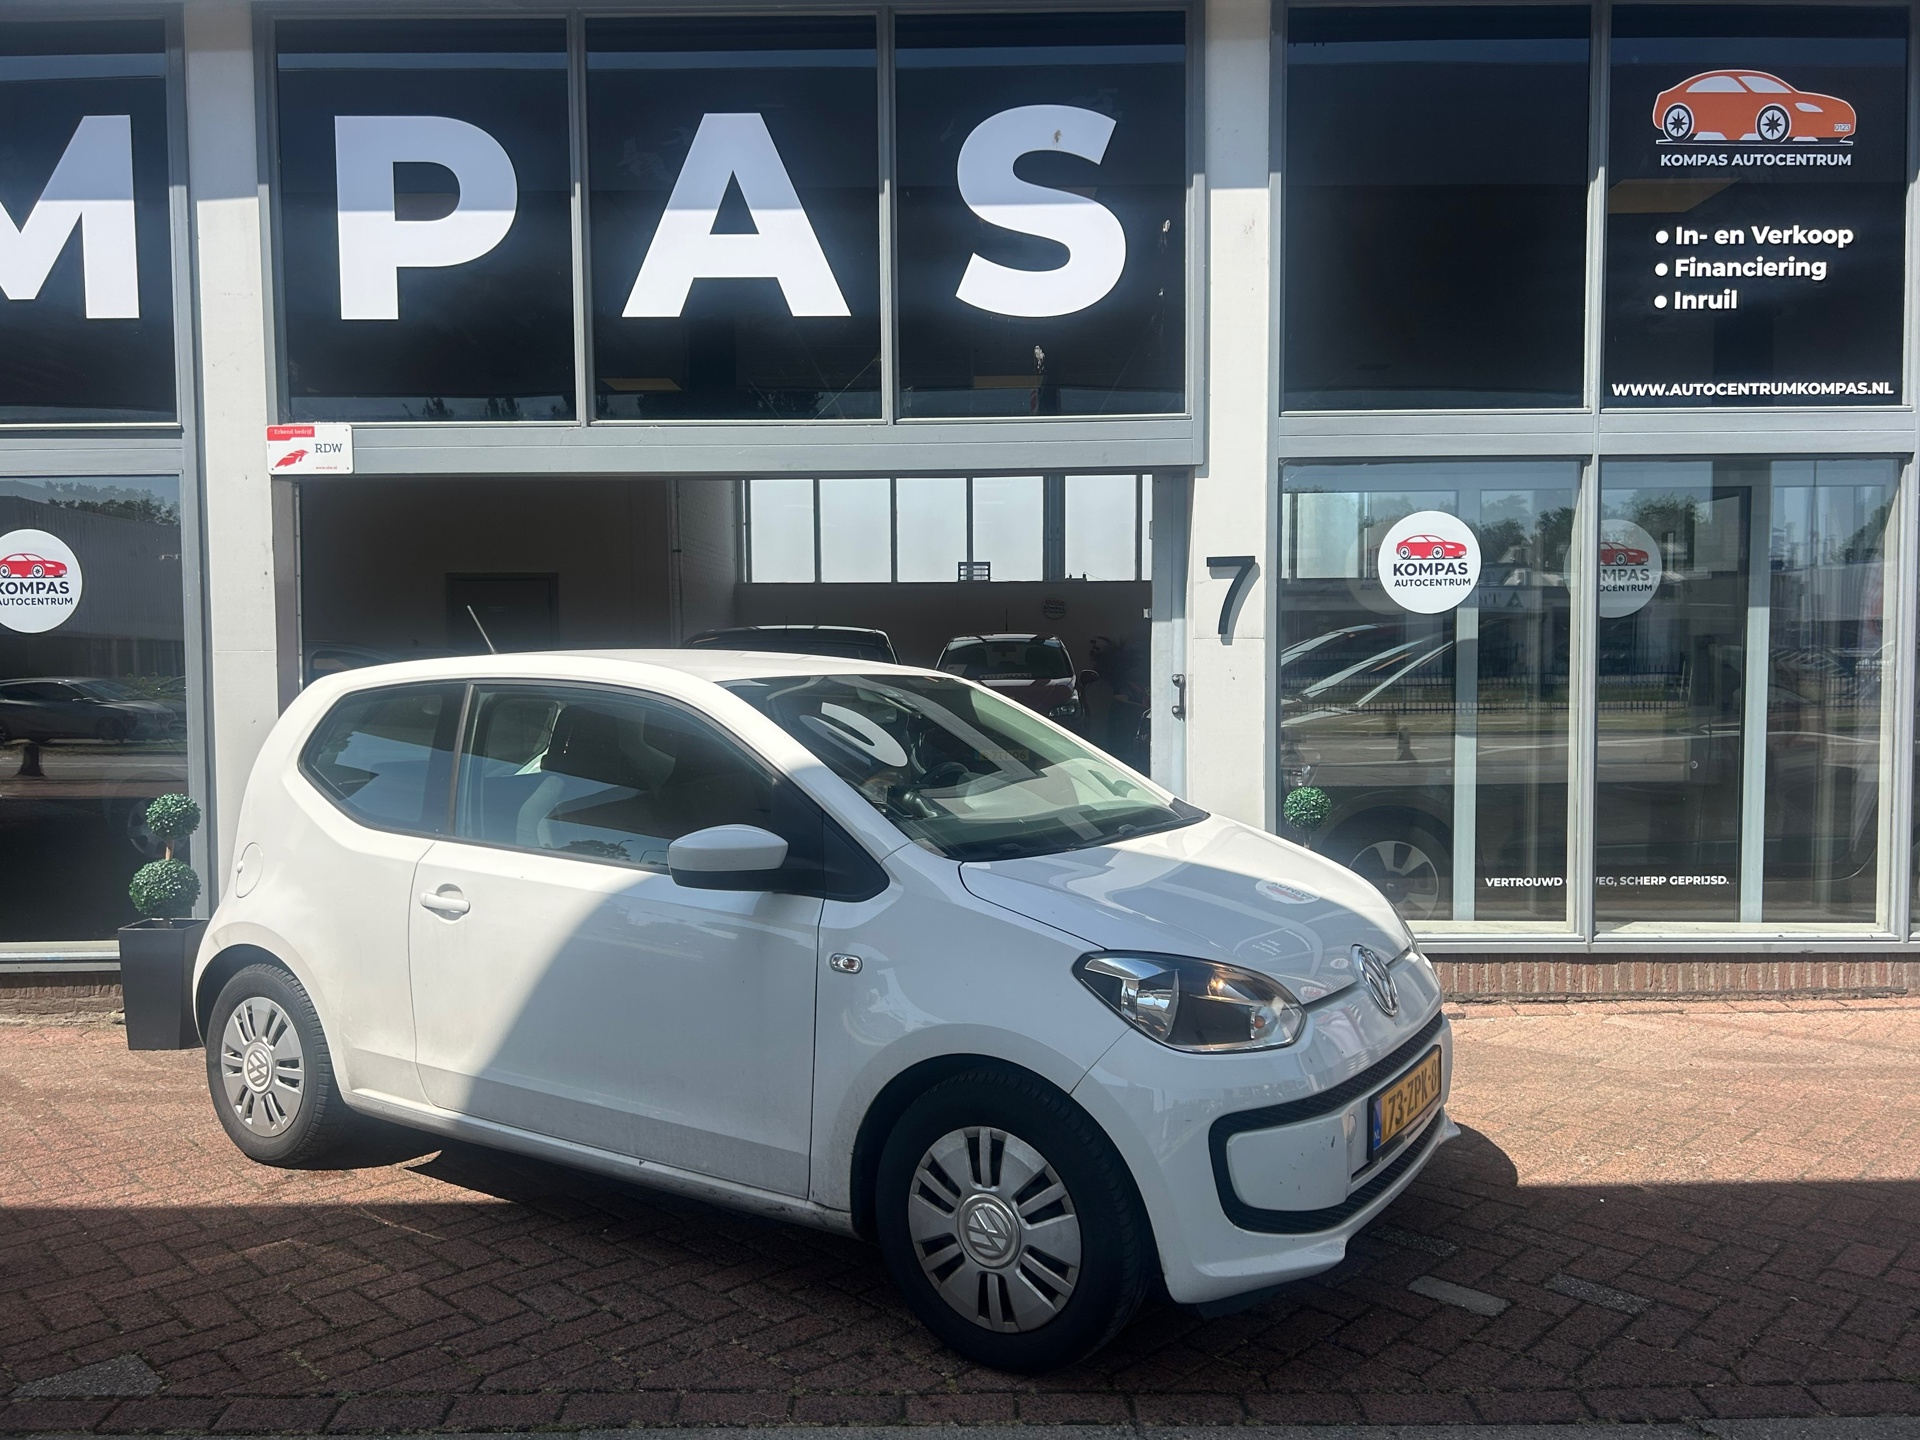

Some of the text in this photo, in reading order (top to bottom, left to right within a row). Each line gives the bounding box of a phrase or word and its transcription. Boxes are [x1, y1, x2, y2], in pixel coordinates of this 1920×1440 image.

[1660, 153, 1852, 167] KOMPAS AUTOCENTRUM
[1675, 225, 1854, 249] In- en Verkoop
[1674, 256, 1828, 281] Financiering
[1674, 288, 1738, 310] Inruil
[1612, 381, 1895, 397] WWW.AUTOCENTRUMKOMPAS.NL
[294, 428, 313, 436] bedrijf
[314, 443, 343, 454] RDW
[1393, 562, 1469, 577] KOMPAS
[1599, 568, 1651, 582] MPAS
[1394, 578, 1471, 588] AUTOCENTRUM
[1206, 555, 1256, 635] 7
[1485, 877, 1563, 887] VERTROUWD
[1619, 876, 1667, 886] SCHERP
[1669, 875, 1730, 886] GEPRIJSD.
[1387, 1059, 1438, 1136] 73-ZPK-8
